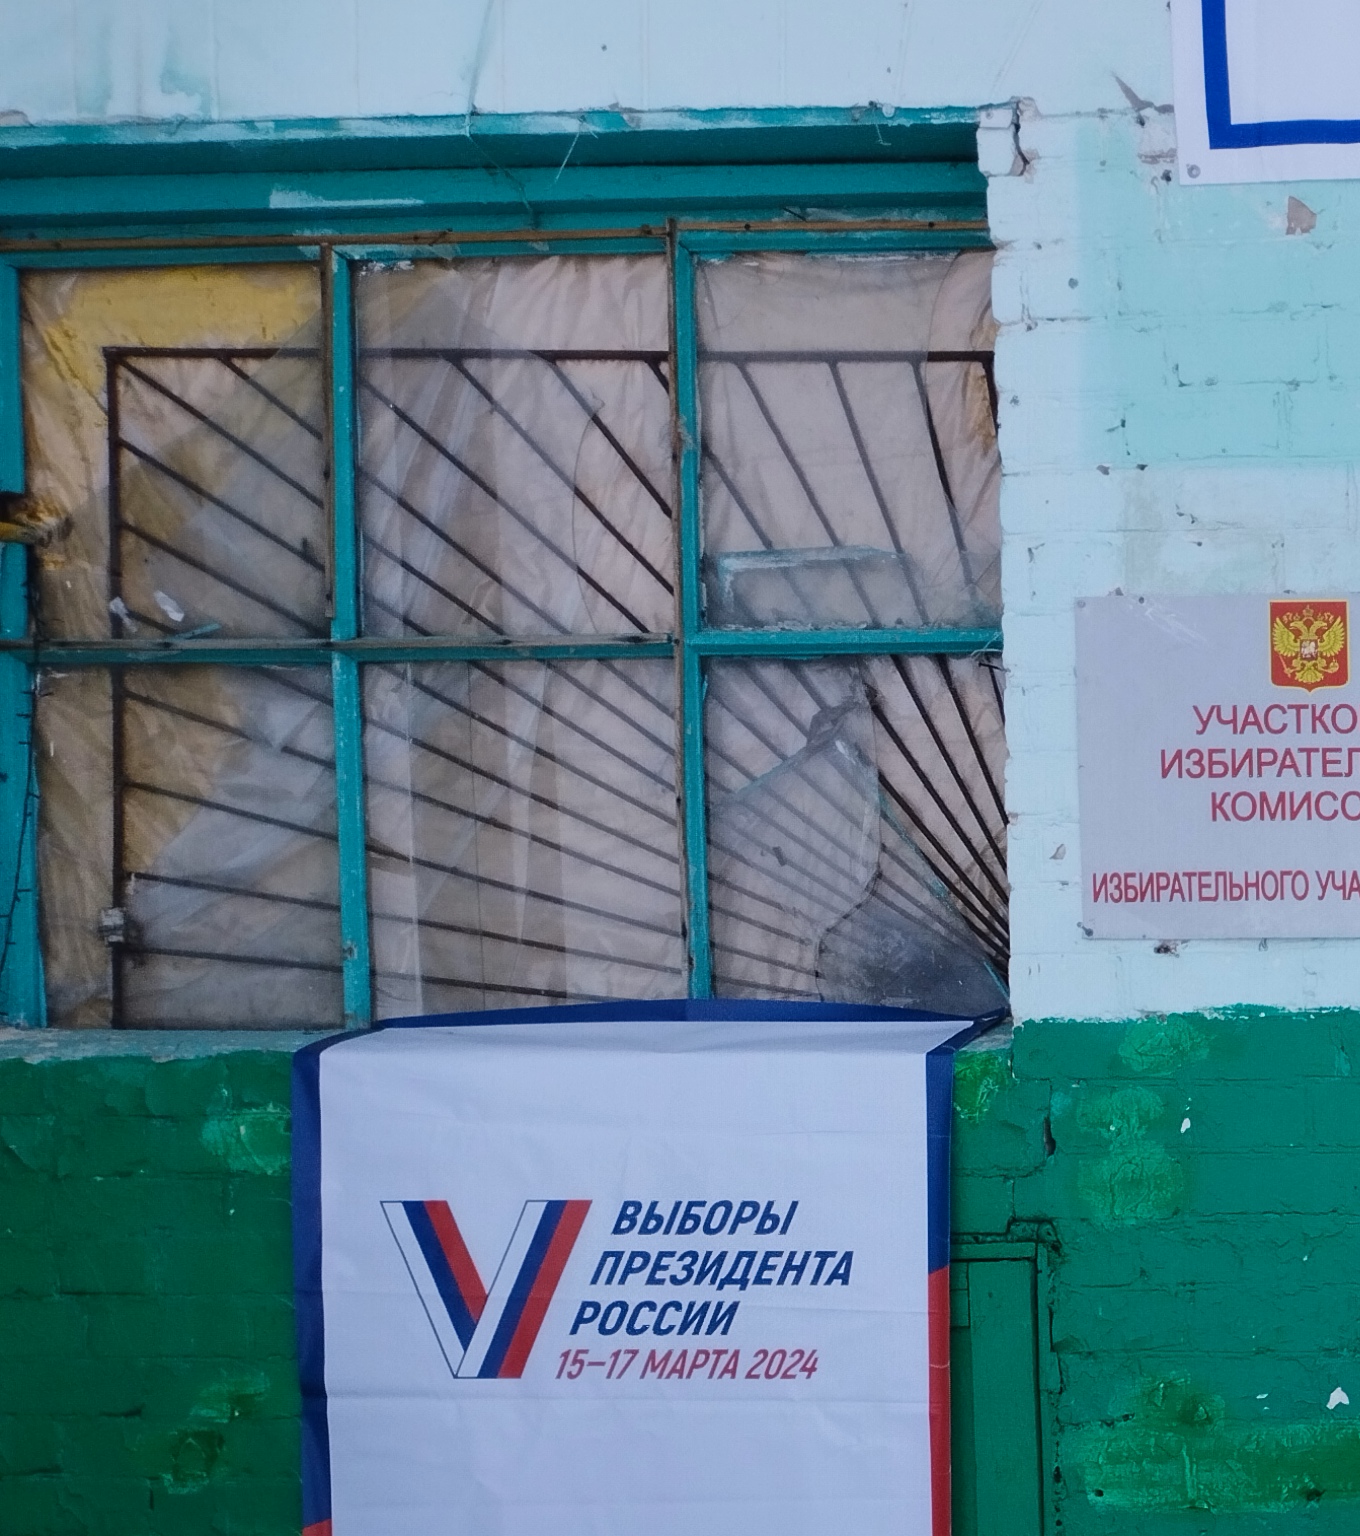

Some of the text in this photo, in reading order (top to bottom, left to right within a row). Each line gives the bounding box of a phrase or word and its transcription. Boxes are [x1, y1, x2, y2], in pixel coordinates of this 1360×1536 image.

[1093, 870, 1309, 903] ИЗБИРАТЕЛЬНОГО
[610, 1200, 799, 1236] ВЫБОРЫ
[589, 1251, 854, 1291] ПРЕЗИДЕНТА
[569, 1301, 740, 1336] РОССИИ
[555, 1350, 818, 1380] 15–17 МАРТА 2024
